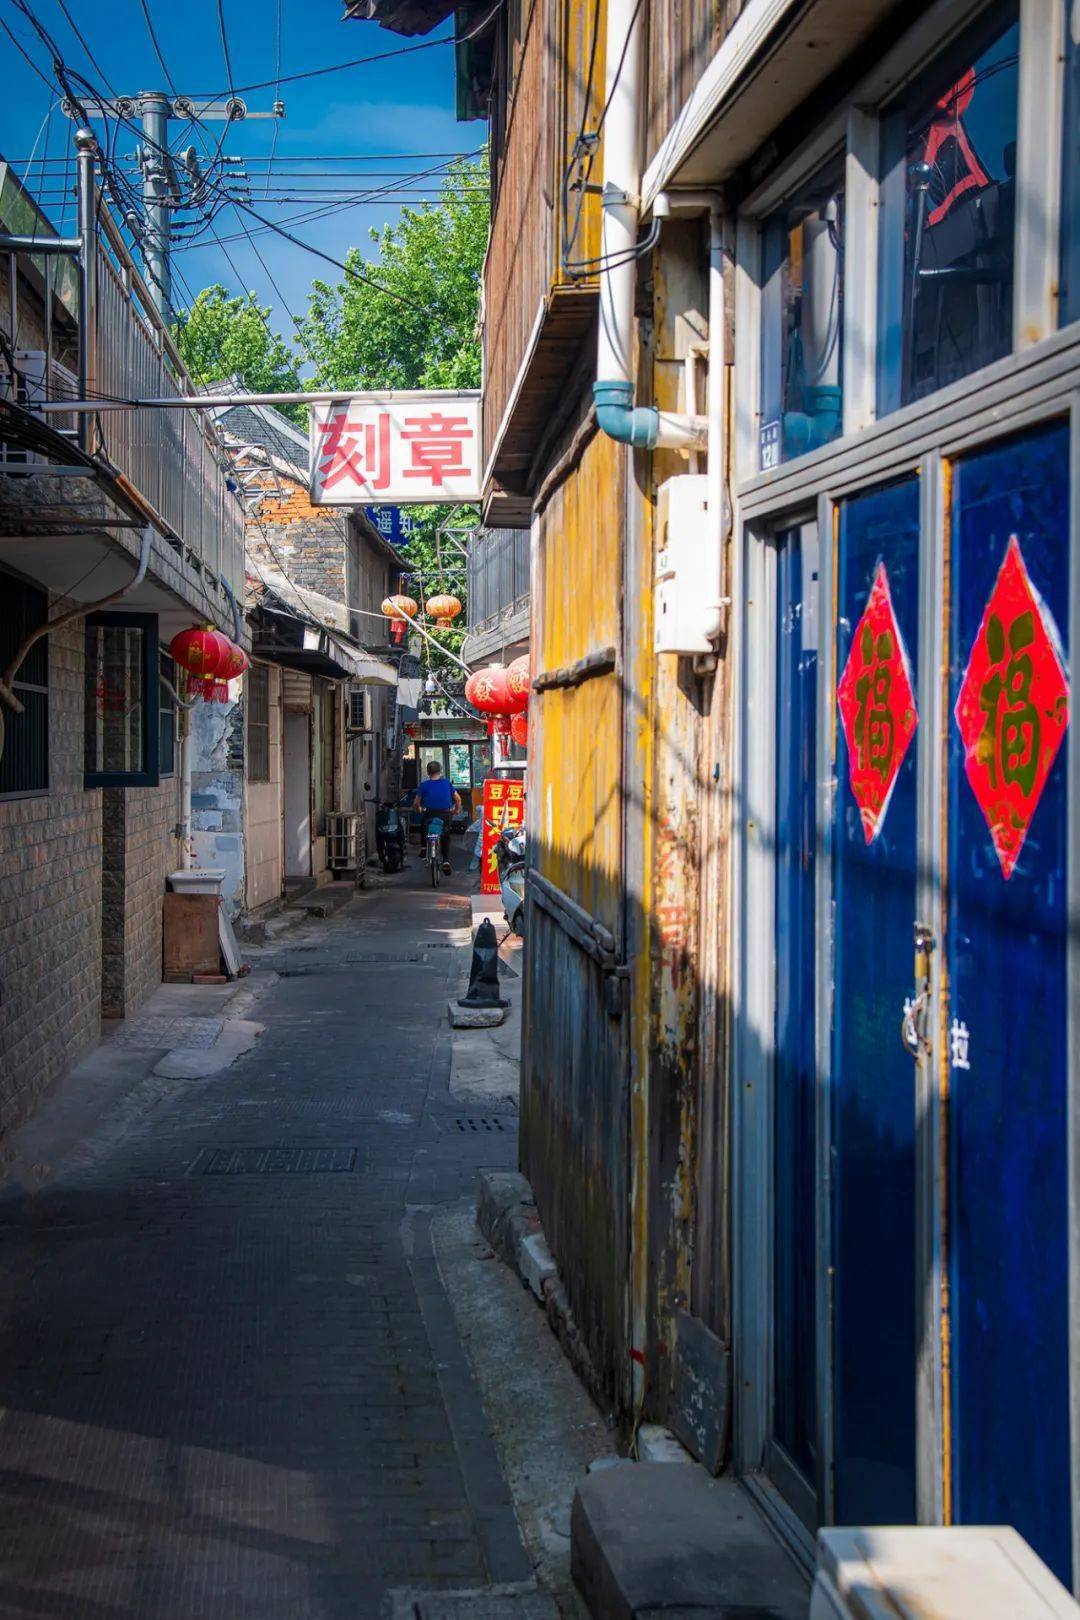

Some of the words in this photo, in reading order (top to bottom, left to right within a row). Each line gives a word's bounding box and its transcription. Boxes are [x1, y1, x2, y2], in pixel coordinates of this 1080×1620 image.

[317, 412, 474, 491] 刻章
[853, 621, 895, 785] 福
[979, 609, 1041, 799] 福
[488, 784, 523, 800] 豆豆
